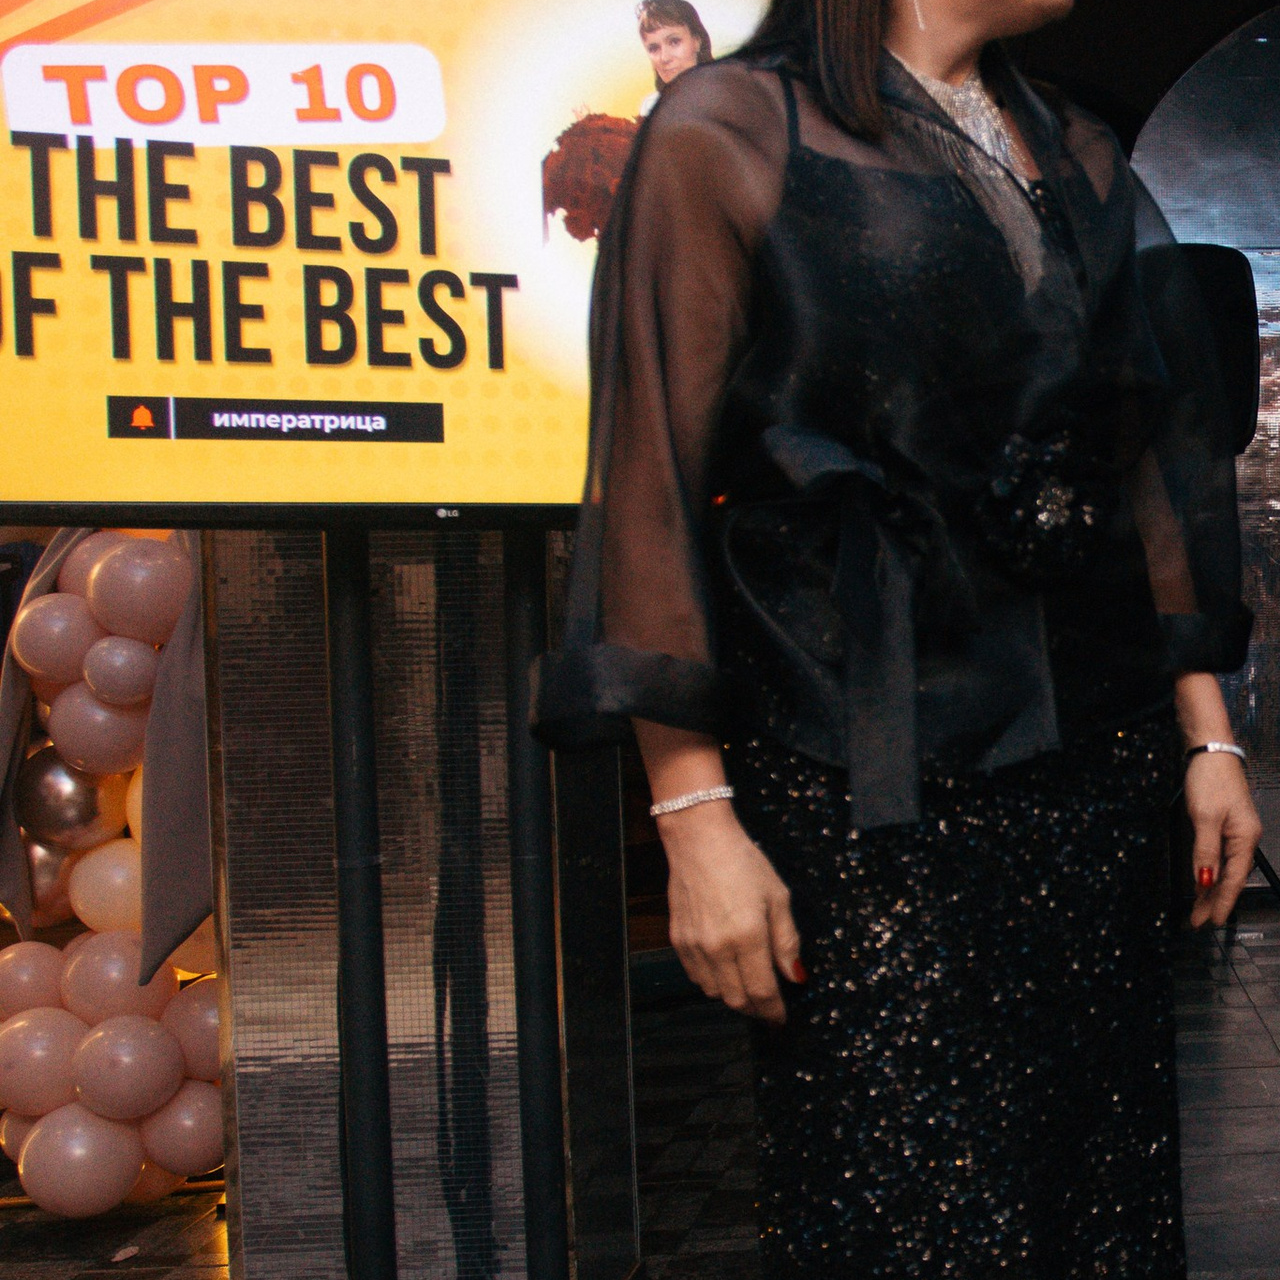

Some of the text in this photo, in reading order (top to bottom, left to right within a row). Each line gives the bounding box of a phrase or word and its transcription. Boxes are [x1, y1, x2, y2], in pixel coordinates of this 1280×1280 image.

[42, 63, 397, 126] TOP 10
[10, 130, 451, 257] THE BEST
[0, 250, 519, 371] F THE BEST
[212, 412, 387, 434] императрица
